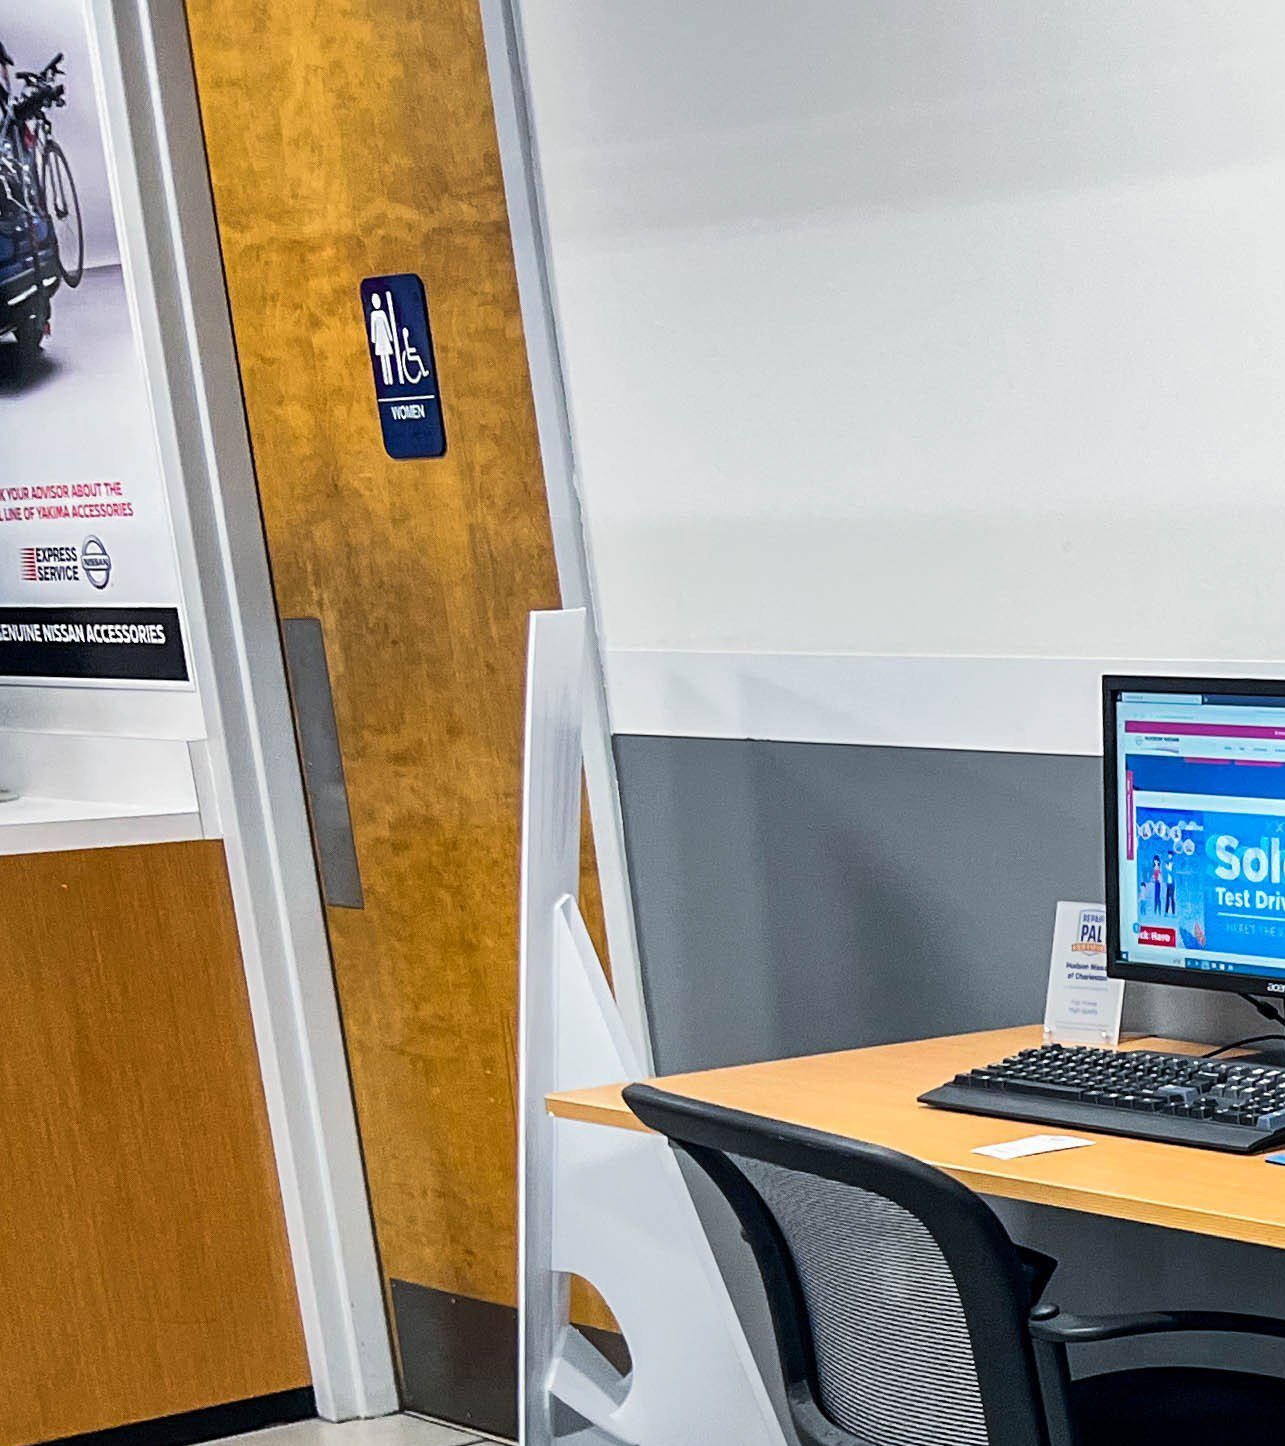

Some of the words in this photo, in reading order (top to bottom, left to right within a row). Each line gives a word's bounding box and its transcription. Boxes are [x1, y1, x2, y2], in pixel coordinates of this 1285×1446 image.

[390, 403, 426, 420] WOMEN
[7, 487, 29, 500] YOUR
[31, 484, 69, 500] ADVISOR
[71, 482, 102, 498] ABOUT
[103, 481, 123, 497] THE
[3, 507, 23, 521] LINE
[23, 506, 35, 520] OF
[36, 504, 70, 520] YAKIMA
[72, 501, 134, 518] ACCESSORIES
[35, 546, 78, 562] EXPRESS
[37, 565, 80, 581] SERVICE
[42, 623, 86, 644] NISSAN
[86, 623, 166, 645] ACCESSORIES
[1215, 886, 1251, 909] Test
[1081, 924, 1102, 943] PAL
